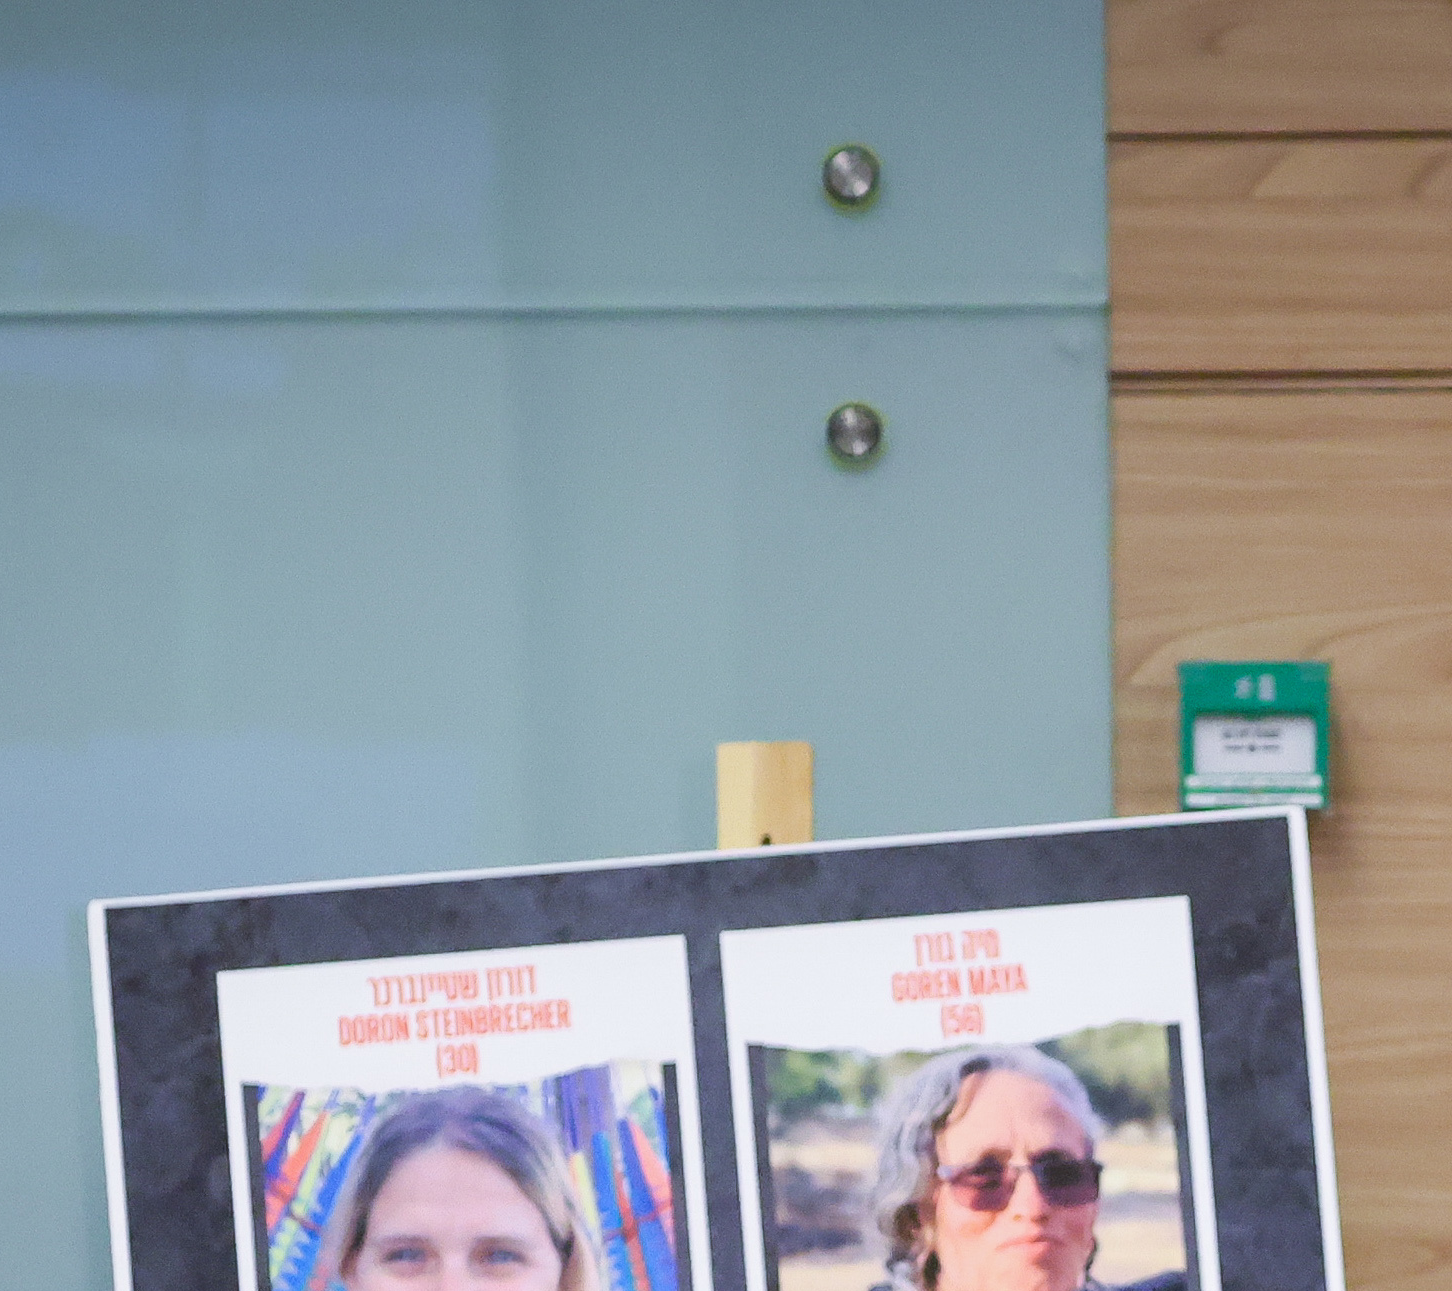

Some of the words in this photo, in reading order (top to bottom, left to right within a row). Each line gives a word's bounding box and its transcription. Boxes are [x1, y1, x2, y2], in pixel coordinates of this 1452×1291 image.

[892, 969, 961, 1002] GOREN
[968, 964, 1028, 995] MAYA
[338, 1014, 410, 1046] DORON
[416, 999, 572, 1039] STEINBRECHER
[437, 1043, 479, 1077] (30)
